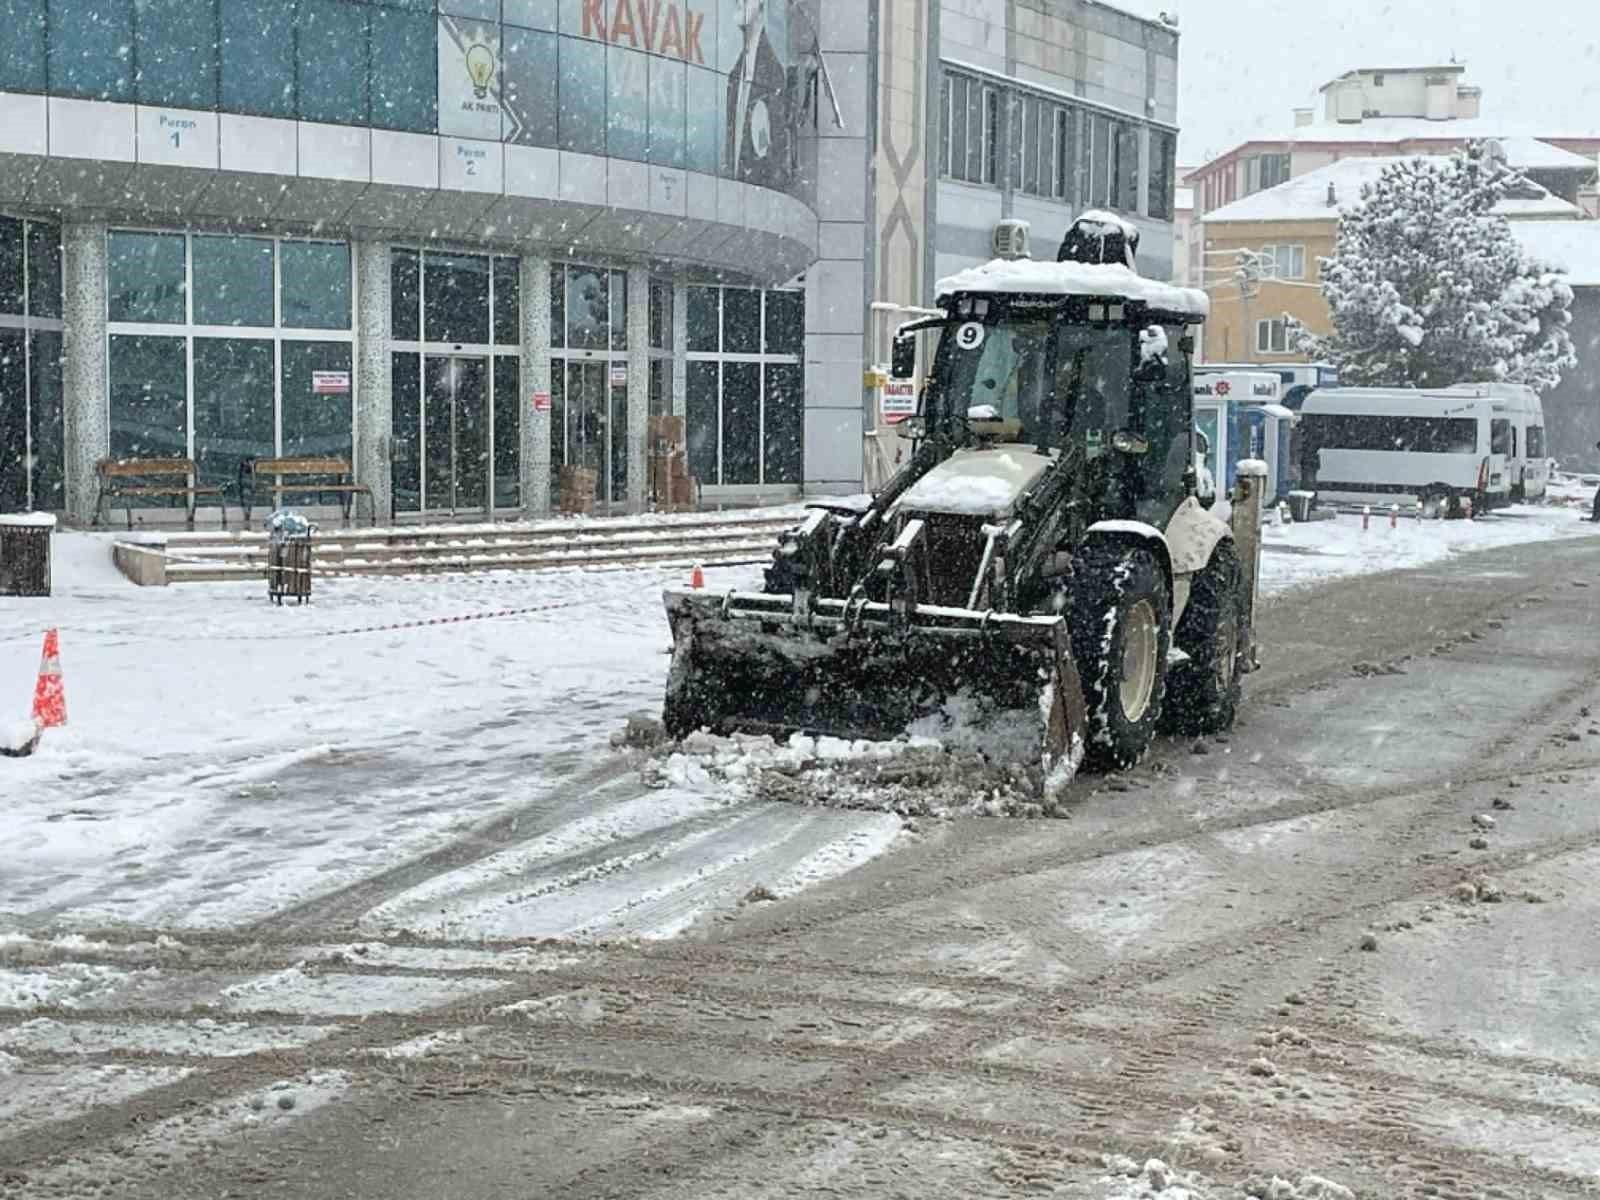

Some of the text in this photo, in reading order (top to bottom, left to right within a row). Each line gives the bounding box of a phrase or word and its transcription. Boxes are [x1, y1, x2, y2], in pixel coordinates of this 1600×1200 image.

[582, 0, 704, 64] KAVAK
[462, 101, 474, 112] AK
[171, 131, 180, 149] 1
[466, 160, 476, 176] 2
[963, 326, 977, 345] 9
